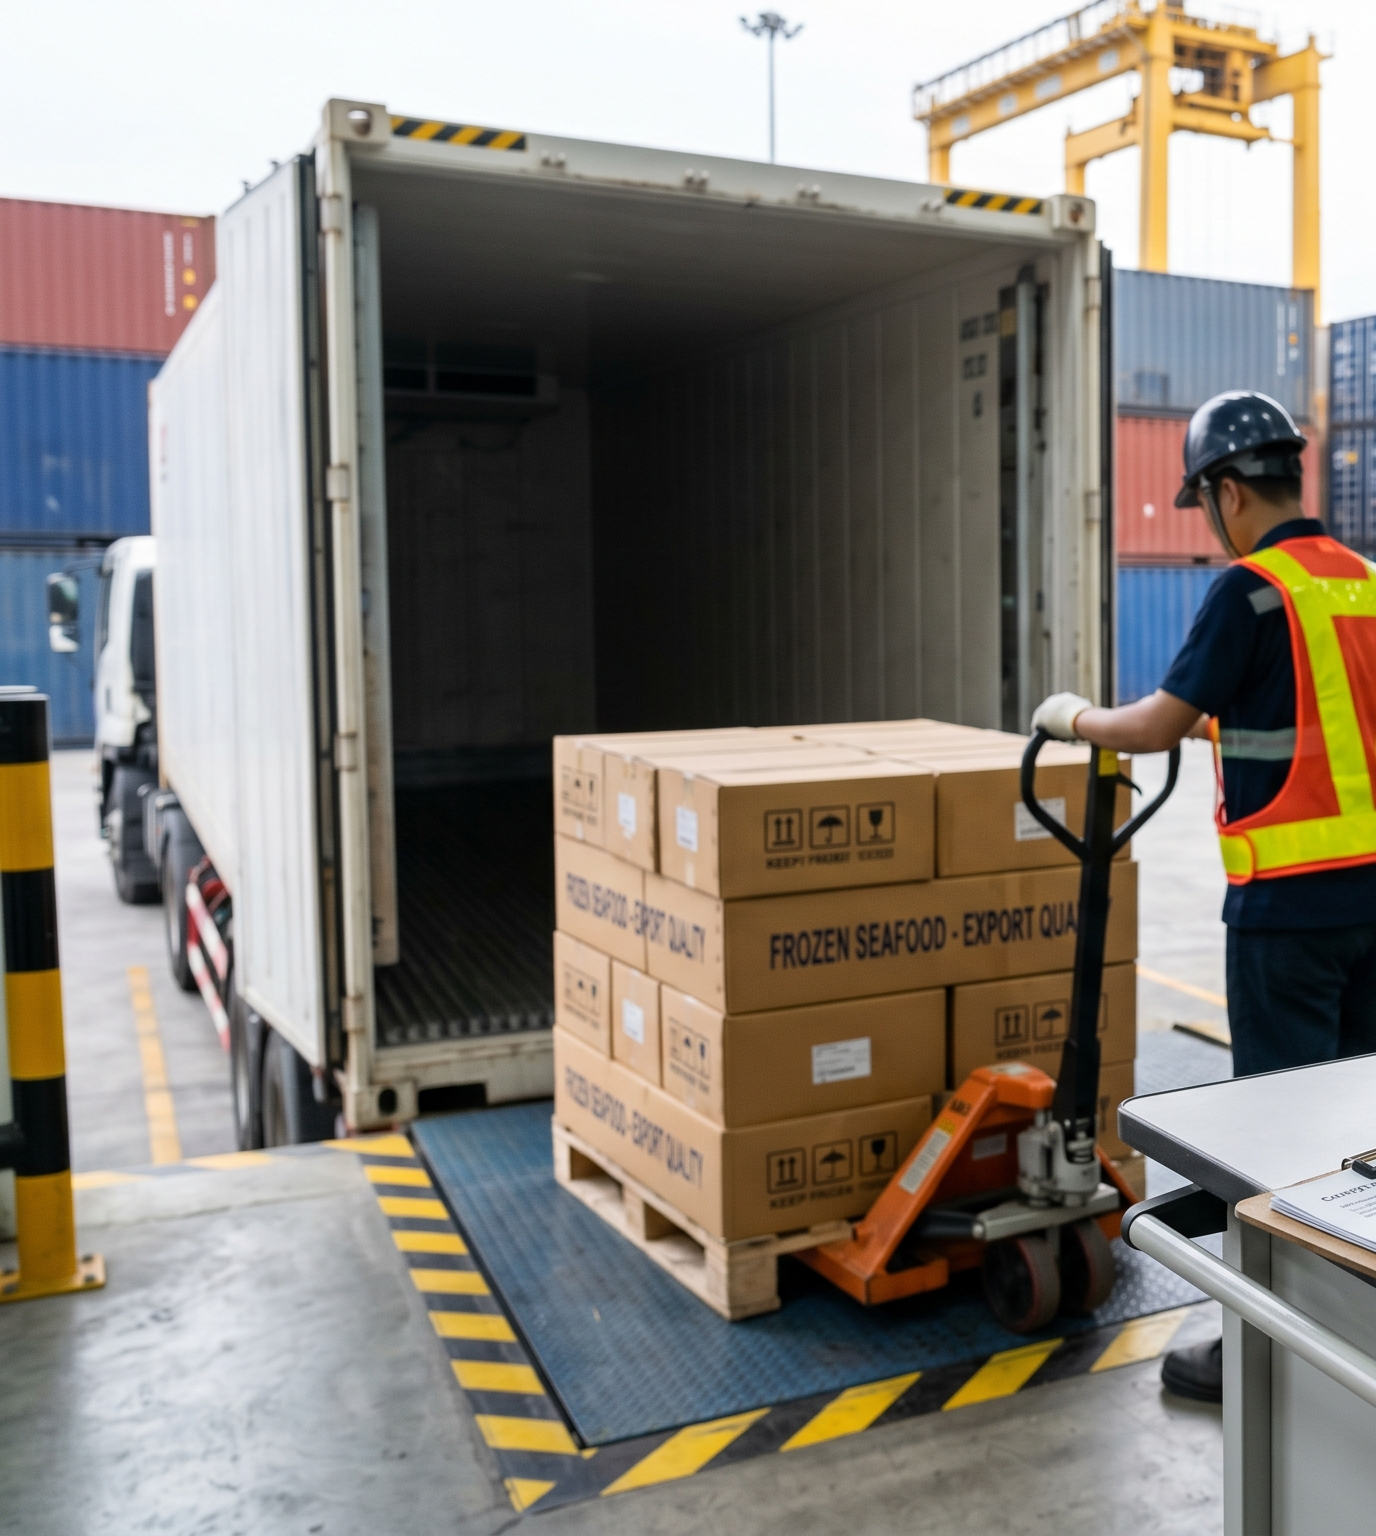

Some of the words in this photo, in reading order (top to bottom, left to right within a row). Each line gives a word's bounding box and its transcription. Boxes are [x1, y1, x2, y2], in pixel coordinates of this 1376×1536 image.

[769, 926, 850, 970] FROZEN
[855, 915, 947, 960] SEAFOOD
[963, 906, 1035, 947] EXPORT
